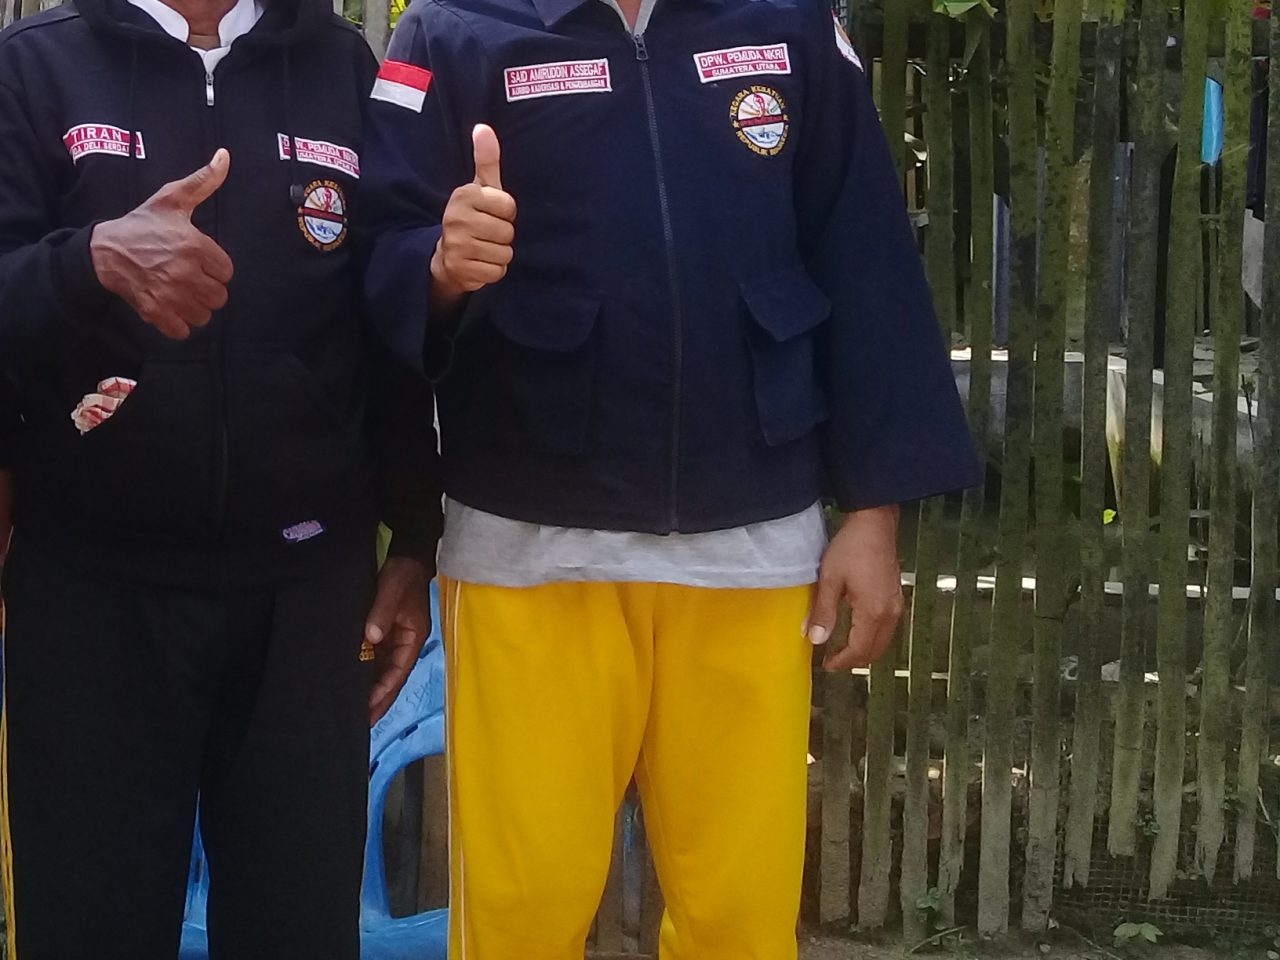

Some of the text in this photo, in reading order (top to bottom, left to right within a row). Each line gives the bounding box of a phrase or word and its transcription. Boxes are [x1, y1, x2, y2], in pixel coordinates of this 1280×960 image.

[701, 48, 784, 68] DPW. PEMUDA NKRI
[510, 71, 528, 83] SAID
[569, 63, 603, 77] ASSEGAF
[711, 63, 780, 77] SUMATERA UTARA
[71, 127, 122, 143] TIRAN
[83, 142, 100, 152] DELI
[308, 143, 340, 157] PEMUDA
